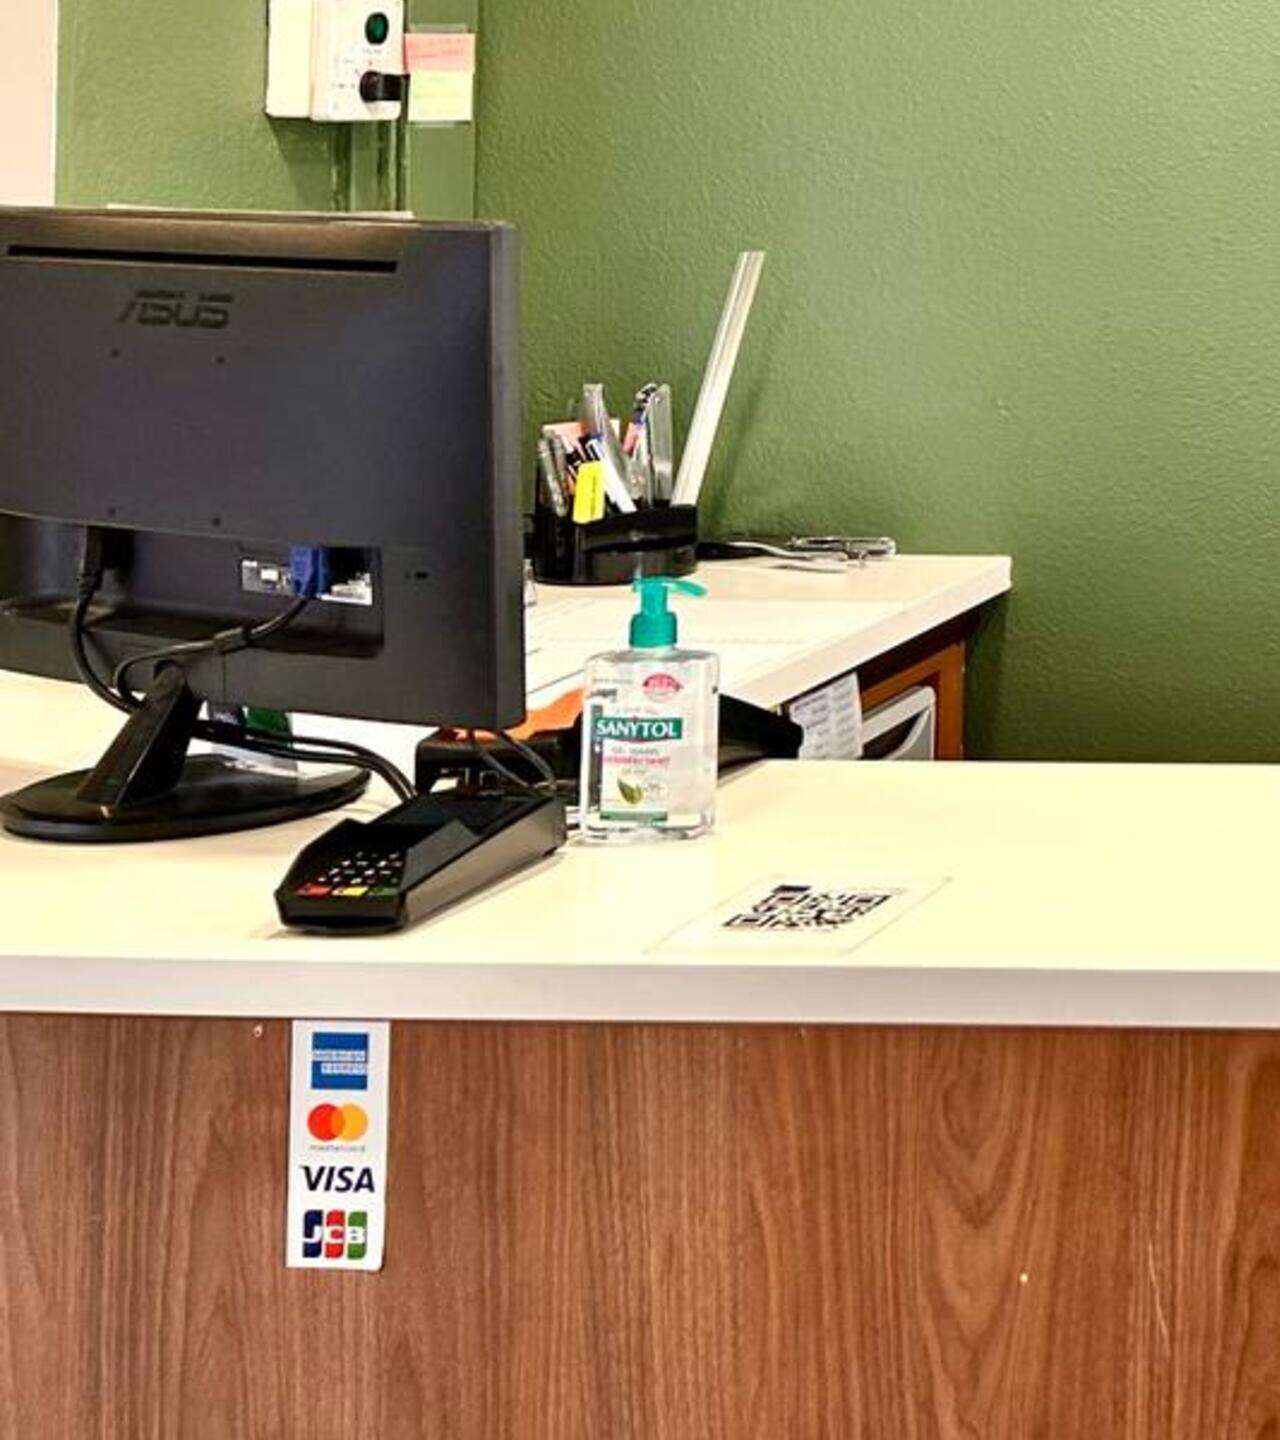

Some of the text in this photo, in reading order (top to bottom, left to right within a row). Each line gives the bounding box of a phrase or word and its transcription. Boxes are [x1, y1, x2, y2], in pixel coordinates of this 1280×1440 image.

[116, 289, 235, 330] ASUS
[596, 719, 678, 739] SANYTOL
[300, 1165, 375, 1194] VISA
